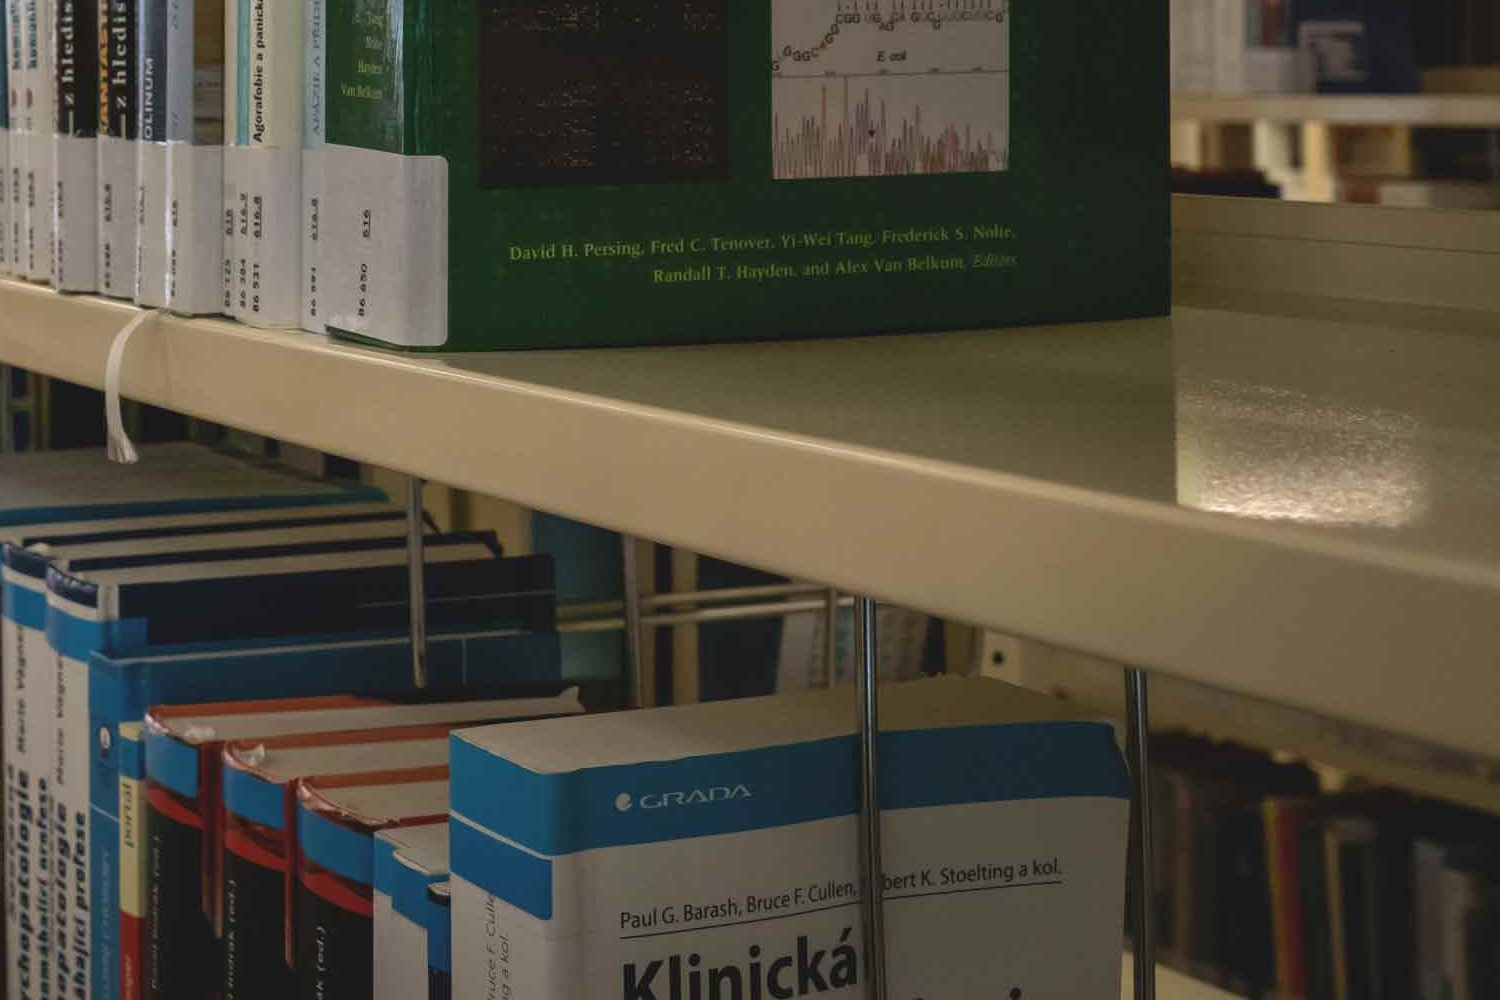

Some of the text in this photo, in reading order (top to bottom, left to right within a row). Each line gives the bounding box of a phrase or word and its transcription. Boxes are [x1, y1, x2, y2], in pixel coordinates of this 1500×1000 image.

[253, 66, 266, 144] Agorafobie
[361, 209, 370, 238] 616
[508, 243, 556, 261] David
[560, 243, 579, 258] H.
[583, 241, 644, 262] Persing,
[650, 238, 684, 255] Fred
[690, 237, 706, 253] C.
[709, 233, 774, 251] Tenover,
[779, 231, 831, 248] Yi-Wei
[881, 225, 949, 243] Frederick
[359, 264, 367, 292] 650
[652, 264, 711, 282] Randall
[716, 264, 733, 280] T.
[802, 259, 829, 276] and
[835, 256, 869, 274] Alex
[874, 257, 902, 273] Van
[639, 783, 756, 809] GRADA
[620, 856, 1062, 929] Paul G. Barash, Bruce F. Cullen, bert K. Stoelting a kol.
[622, 927, 859, 1000] Klinická
